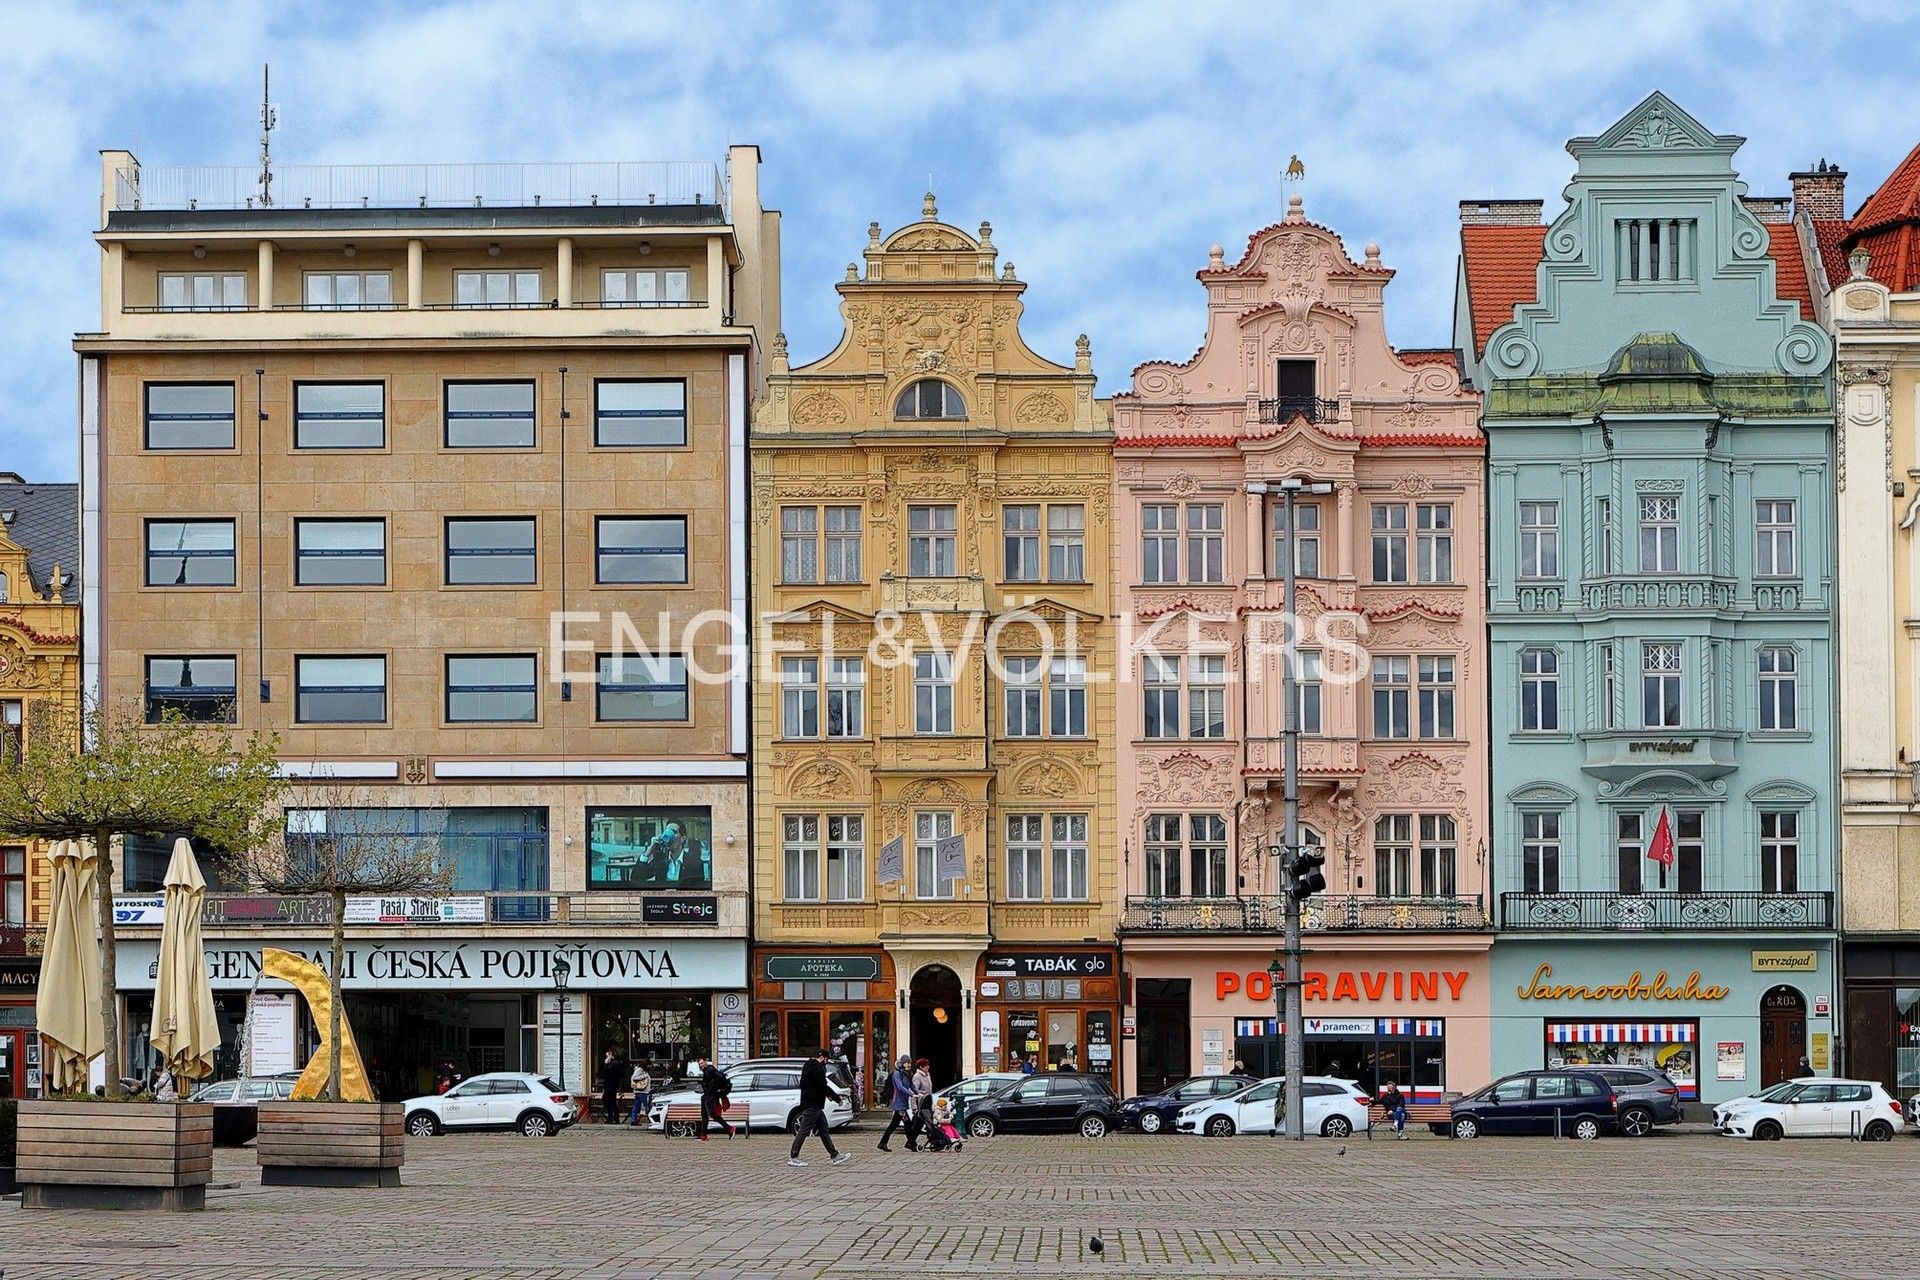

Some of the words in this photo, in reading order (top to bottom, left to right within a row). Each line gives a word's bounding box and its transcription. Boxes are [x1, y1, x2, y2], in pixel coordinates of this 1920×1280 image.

[116, 911, 145, 921] 97
[672, 903, 713, 916] Strejc
[367, 944, 471, 979] ČESKÁ
[481, 943, 680, 979] POJIŠŤOVNA
[800, 964, 844, 972] APOTEKA
[1024, 956, 1077, 972] TABÁK
[1085, 956, 1105, 973] glo
[1216, 971, 1470, 1000] PORAVINY
[1517, 962, 1730, 1000] Samoobsluha
